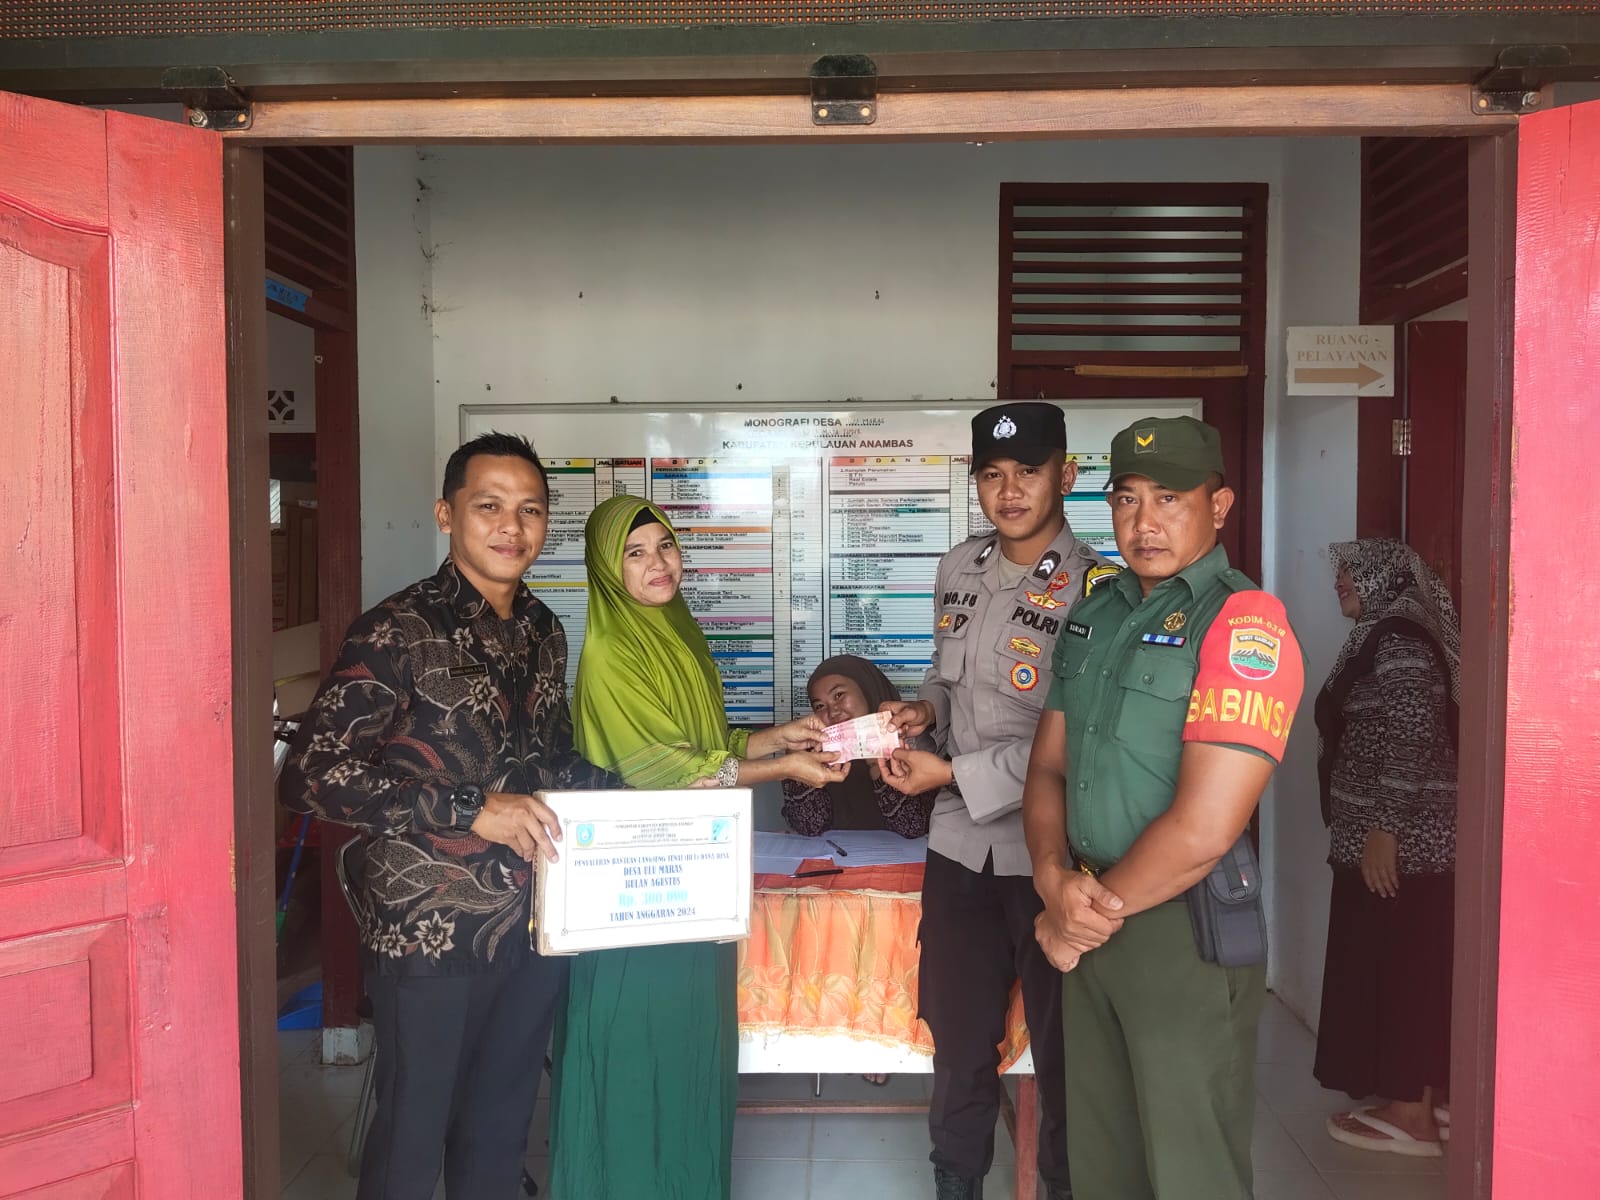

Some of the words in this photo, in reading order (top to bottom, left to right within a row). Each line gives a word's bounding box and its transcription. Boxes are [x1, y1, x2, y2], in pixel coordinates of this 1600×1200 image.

[1316, 334, 1369, 345] RUANG
[1297, 350, 1388, 361] PELAYANAN
[744, 418, 810, 427] MONOGRAFI
[812, 418, 842, 427] DESA
[859, 439, 914, 448] ANAMBAS
[1012, 606, 1059, 635] POLRI
[623, 866, 641, 876] DESA
[659, 864, 683, 875] MARAS
[625, 879, 648, 889] BULAN
[650, 877, 681, 887] AGUSTUS
[610, 911, 634, 922] TAHUN
[636, 909, 676, 920] ANGGARAN
[677, 907, 696, 917] 2024
